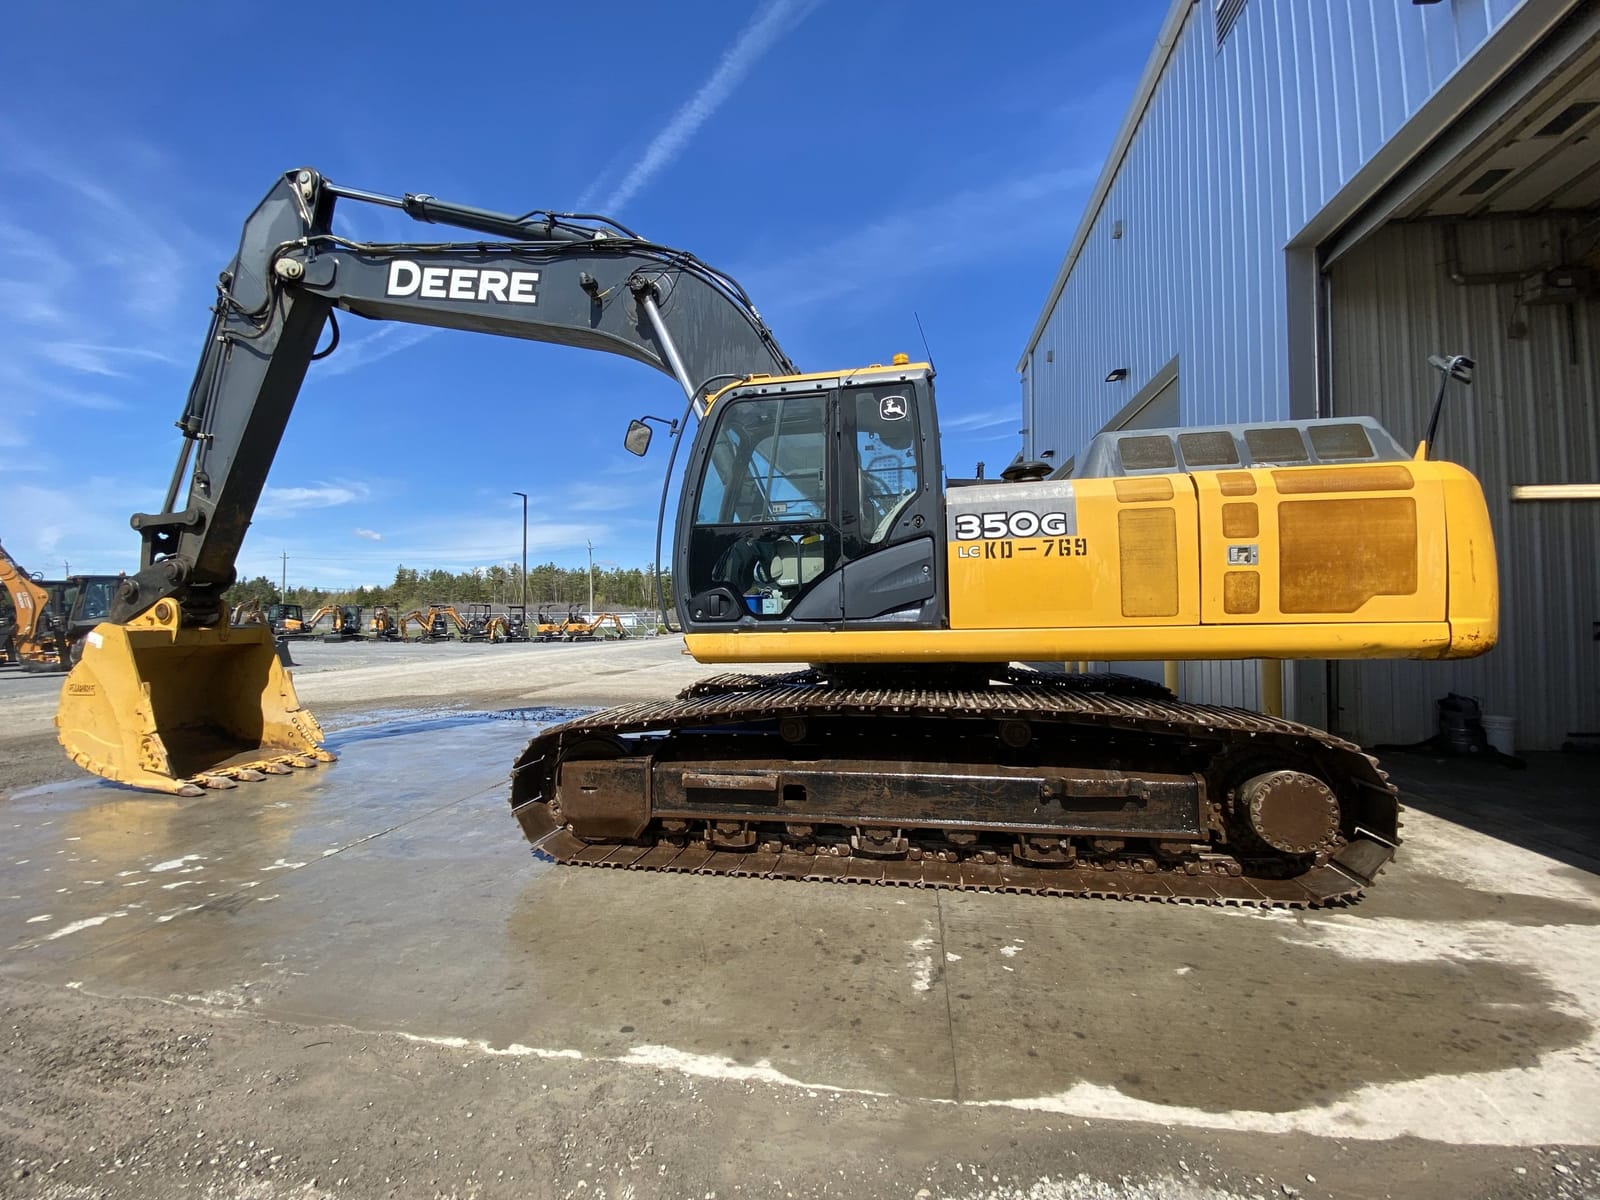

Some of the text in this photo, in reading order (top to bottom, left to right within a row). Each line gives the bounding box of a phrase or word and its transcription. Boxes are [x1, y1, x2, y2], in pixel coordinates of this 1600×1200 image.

[387, 260, 539, 303] DEERE
[955, 510, 1067, 540] 350G
[958, 546, 980, 558] LC
